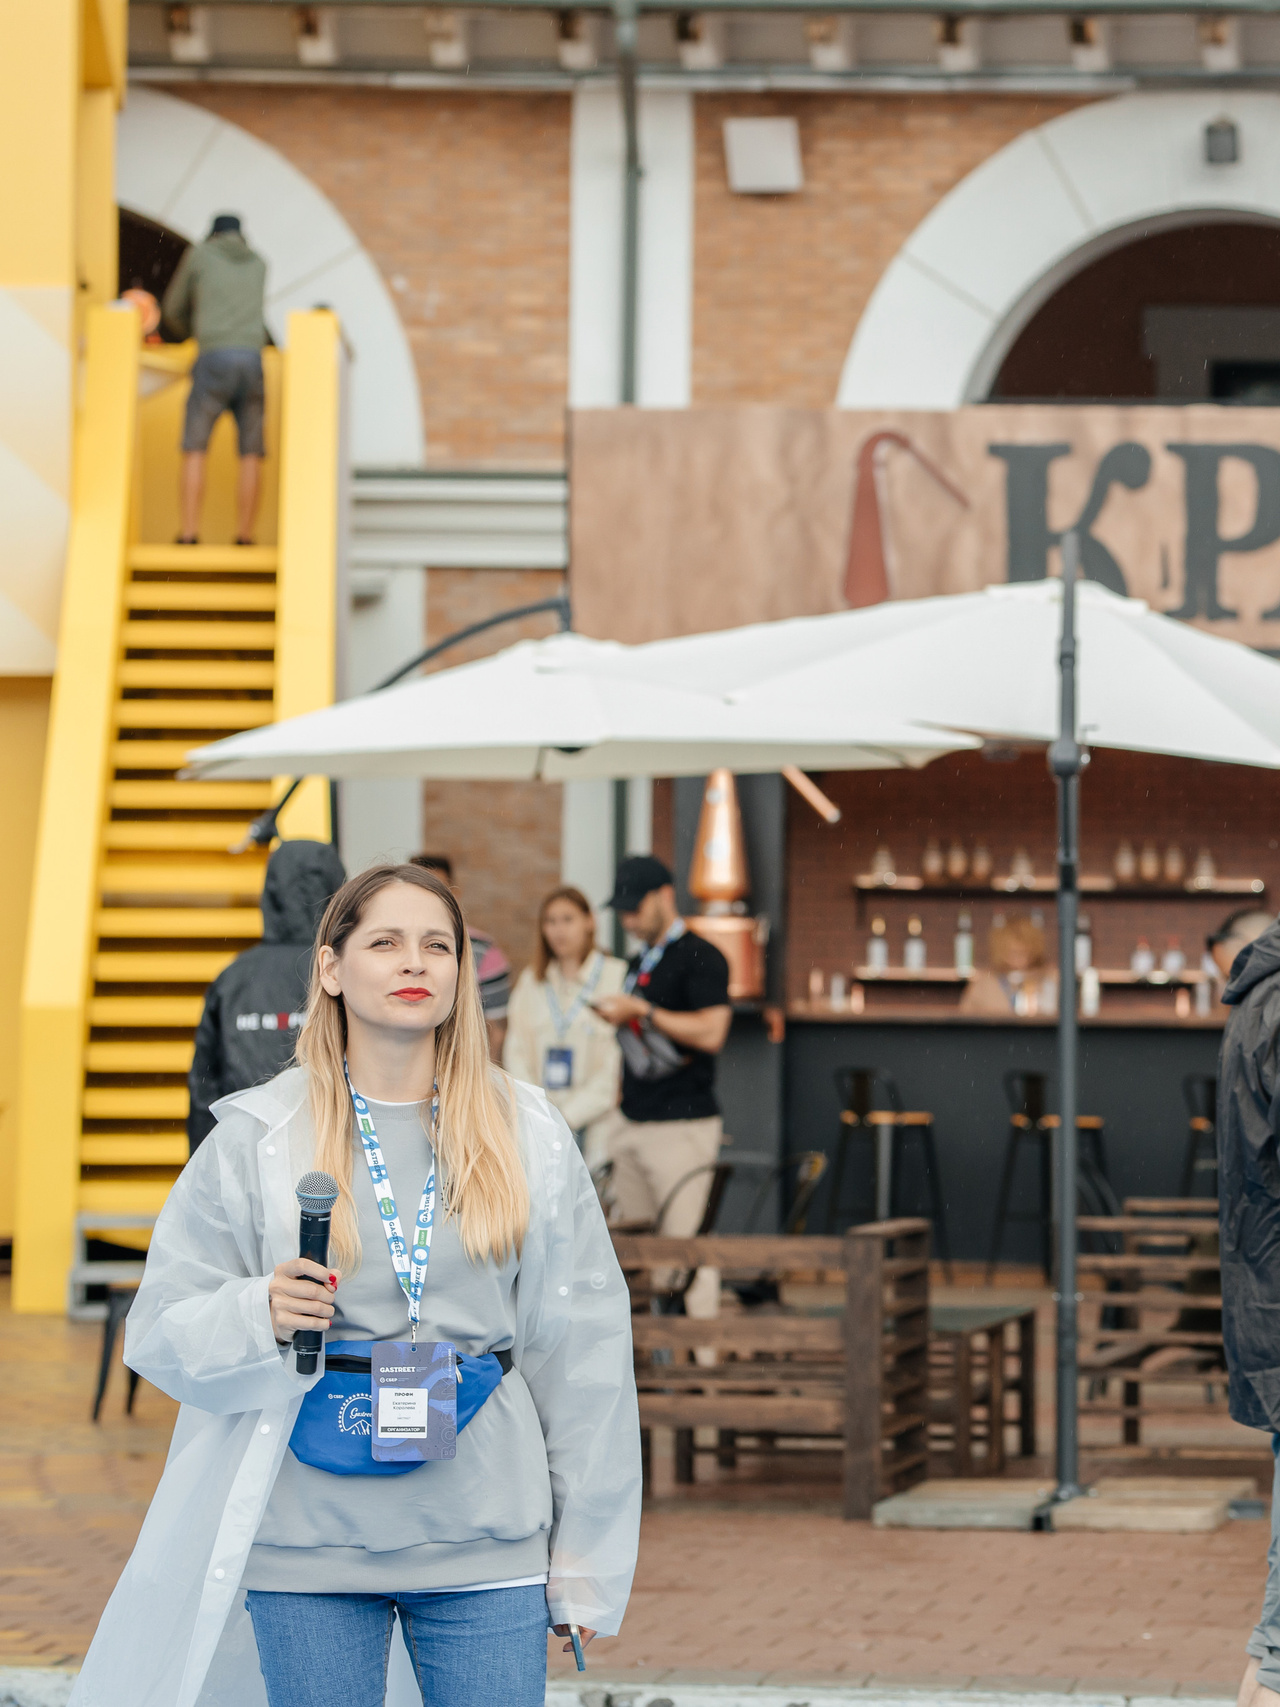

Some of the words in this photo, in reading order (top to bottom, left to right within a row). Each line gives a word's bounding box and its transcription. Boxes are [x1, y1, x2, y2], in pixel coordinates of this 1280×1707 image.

[368, 1141, 383, 1178] GASTREET
[389, 1221, 403, 1258] GASTREET
[349, 1407, 373, 1420] Gastree
